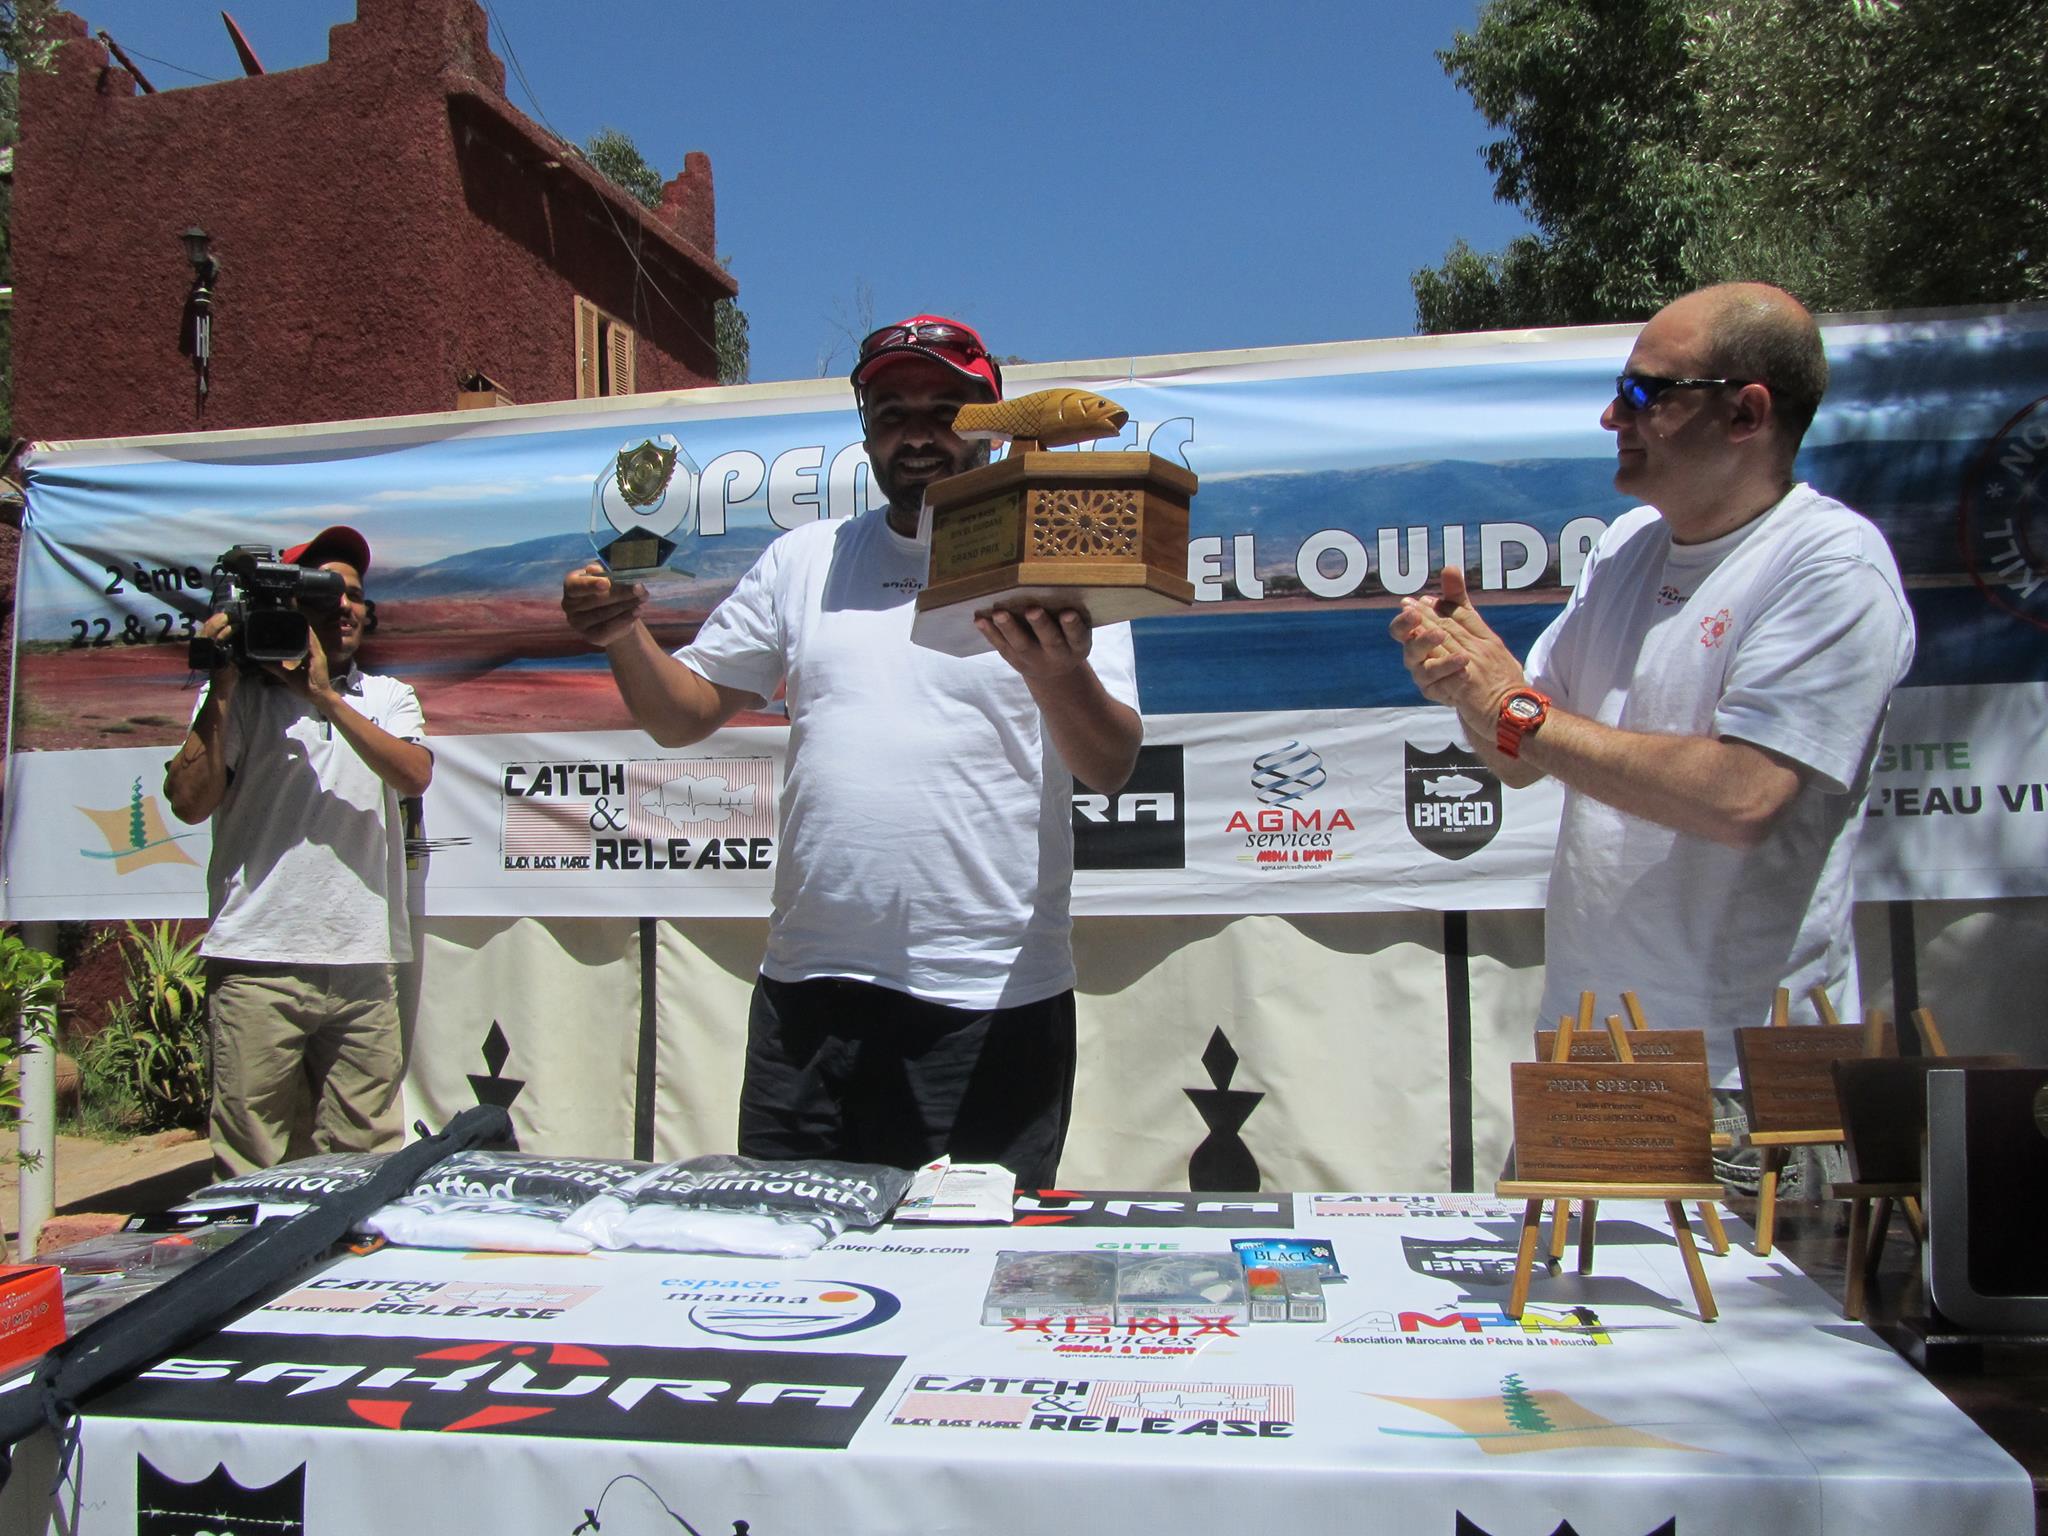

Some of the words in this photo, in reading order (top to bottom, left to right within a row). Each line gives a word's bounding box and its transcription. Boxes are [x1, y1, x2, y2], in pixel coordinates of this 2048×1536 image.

[1984, 518, 2045, 599] KILL
[1187, 535, 1264, 602] EL
[104, 565, 125, 595] 2
[133, 560, 203, 593] ème
[70, 617, 112, 648] 22
[123, 614, 147, 646] &
[155, 612, 197, 642] 23
[1874, 742, 1971, 772] GITE
[505, 763, 625, 797] CATCH
[1997, 784, 2048, 813] VI
[589, 797, 627, 832] &
[1225, 809, 1355, 833] AGMA
[1245, 831, 1332, 848] services
[505, 856, 530, 869] BLACK
[534, 856, 557, 869] BASS
[560, 856, 590, 869] MAROC
[595, 838, 773, 870] RELEASE
[1546, 1079, 1591, 1093] PRIX
[1596, 1079, 1672, 1093] SPECIAL
[1314, 1195, 1435, 1203] CATCH
[1095, 1242, 1181, 1250] GITE
[1255, 1250, 1313, 1262] BLACK
[306, 1278, 448, 1292] CATCH
[661, 1278, 781, 1290] espace
[380, 1290, 426, 1303] &
[663, 1292, 809, 1305] marina
[360, 1303, 566, 1320] RELEASE
[1037, 1334, 1197, 1346] services
[1334, 1335, 1404, 1345] Association
[1406, 1336, 1466, 1345] Marocaine
[1469, 1336, 1484, 1345] de
[1536, 1337, 1547, 1347] la
[1550, 1337, 1597, 1347] Mouche
[1053, 1345, 1112, 1354] MEDIA
[1140, 1346, 1197, 1355] EVENT
[914, 1376, 1090, 1395] CATCH
[1032, 1394, 1086, 1414] &
[892, 1417, 932, 1426] BLACK
[938, 1418, 972, 1428] BASS
[978, 1420, 1022, 1429] MAROC
[1029, 1414, 1295, 1438] RELEASE
